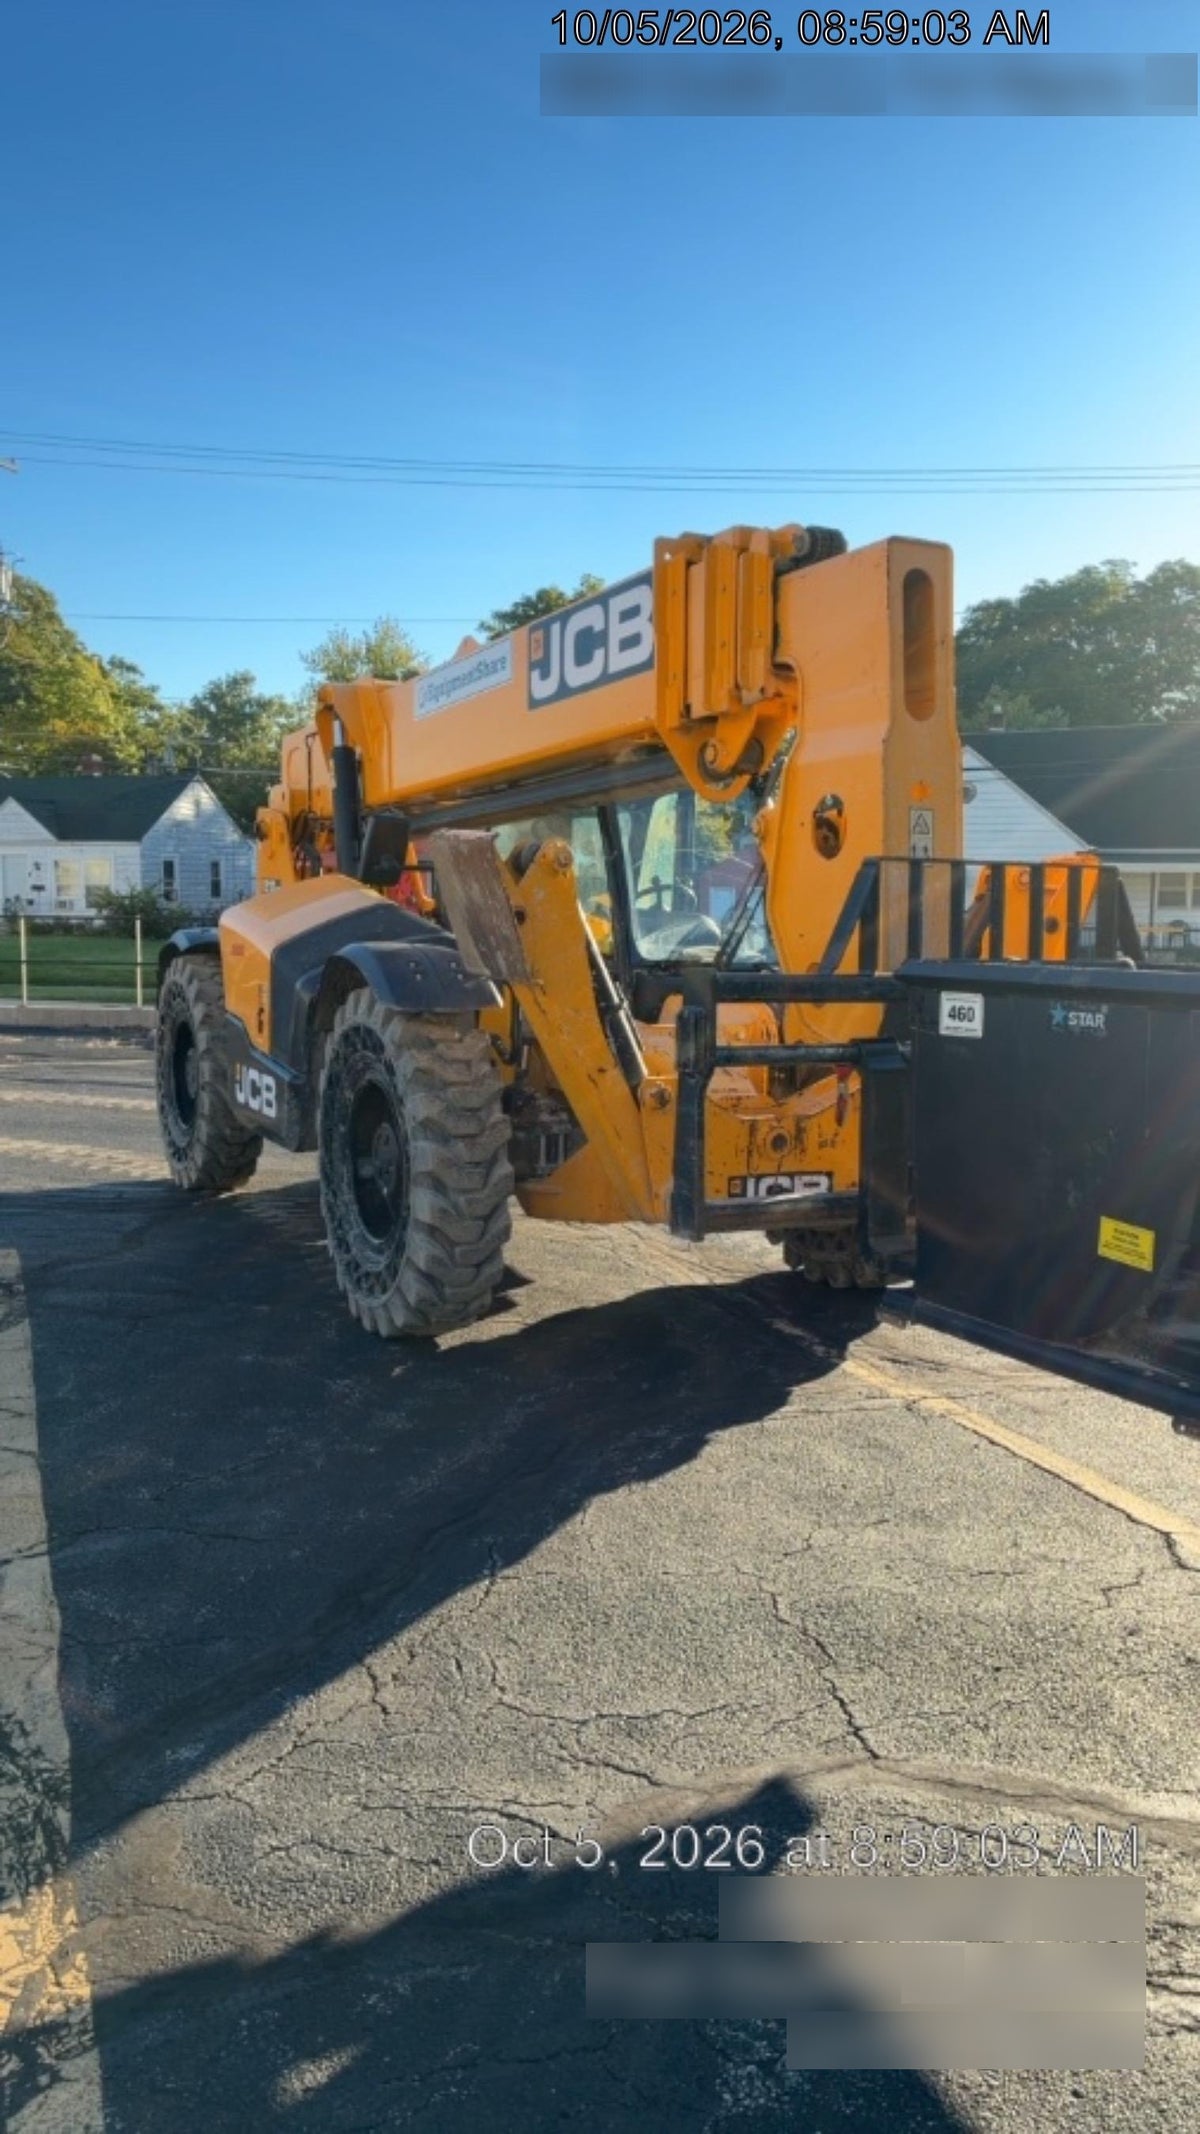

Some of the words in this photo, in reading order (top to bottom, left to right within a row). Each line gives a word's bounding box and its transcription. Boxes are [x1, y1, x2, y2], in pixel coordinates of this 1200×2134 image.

[531, 584, 655, 700] JCB
[947, 1005, 975, 1023] 460
[1068, 1011, 1105, 1028] STAR
[234, 1065, 276, 1118] JCB
